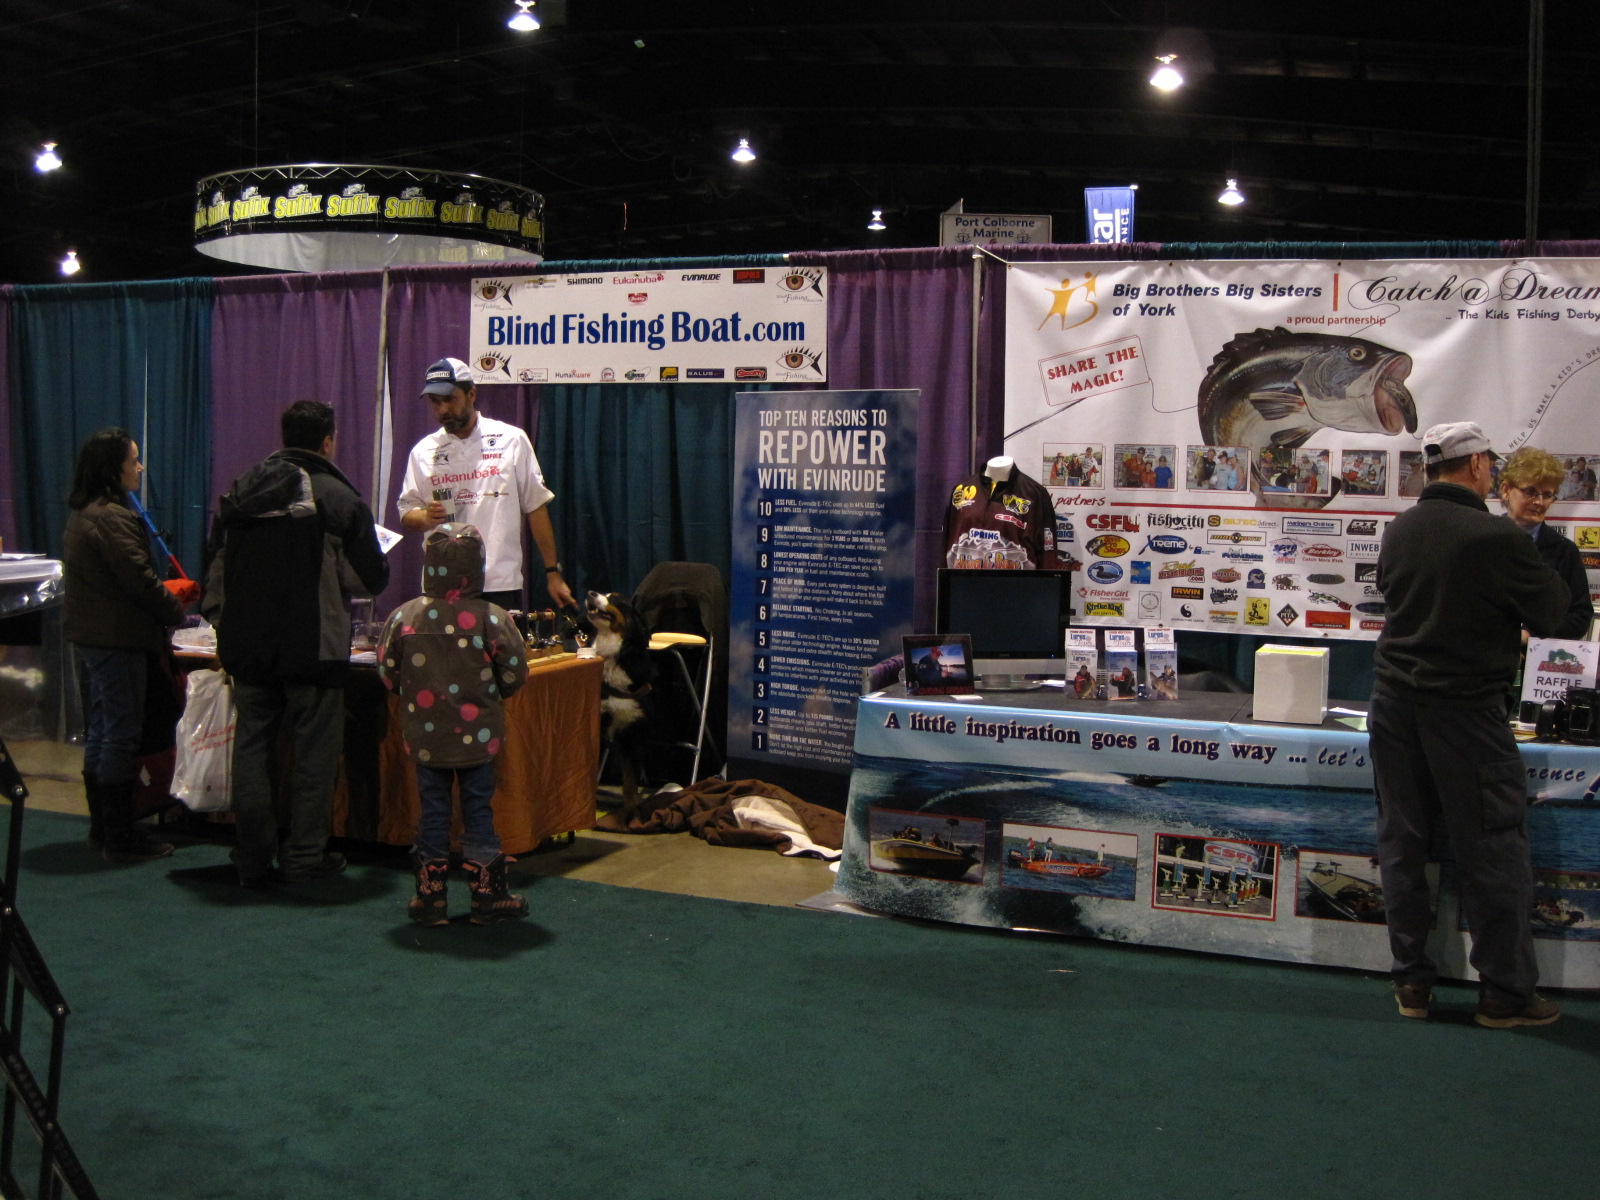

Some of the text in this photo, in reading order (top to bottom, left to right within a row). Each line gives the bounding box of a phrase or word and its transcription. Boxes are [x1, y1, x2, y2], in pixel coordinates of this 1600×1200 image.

[233, 196, 271, 221] Sufix
[274, 193, 323, 219] Sufix
[327, 193, 380, 217] Sufix
[385, 197, 436, 218] Sufix
[440, 202, 484, 223] Sufix
[956, 217, 1035, 228] Port Colborne
[973, 228, 1014, 238] Marine
[567, 277, 603, 286] SHIMANO
[613, 275, 657, 285] Eukanuba
[682, 274, 721, 282] EVINRUDE
[1113, 284, 1322, 299] Big Brothers Big Sisters
[1113, 303, 1177, 317] of York
[1458, 309, 1479, 320] The
[1485, 309, 1510, 320] Kids
[1517, 309, 1560, 321] Fishing
[1566, 308, 1600, 322] Derby
[1286, 315, 1387, 326] a proud partnership
[488, 311, 805, 351] Blind Fishing Boat.com
[1047, 347, 1139, 380] SHARE THE
[1070, 370, 1125, 394] MAGIC!
[1508, 431, 1526, 449] HELP
[1528, 418, 1537, 429] US
[1536, 393, 1551, 415] MAKE
[1557, 358, 1582, 380] KID'S
[759, 410, 887, 427] TOP TEN REASONS TO
[758, 430, 887, 465] REPOWER
[430, 469, 490, 487] Eukanuba
[758, 468, 886, 492] WITH EVINRUDE
[1056, 494, 1106, 509] partners
[760, 502, 771, 516] 10
[762, 528, 768, 542] 9
[970, 531, 999, 540] SPRING
[1307, 548, 1339, 557] Berkley
[1350, 543, 1379, 552] INWEB
[761, 554, 767, 568] 8
[761, 580, 766, 594] 7
[760, 606, 766, 620] 6
[759, 632, 765, 646] 5
[758, 658, 764, 671] 4
[1536, 676, 1582, 688] RAFFLE
[758, 683, 764, 697] 3
[757, 709, 764, 723] 2
[757, 735, 761, 748] 1
[884, 711, 901, 729] A
[909, 712, 957, 734] little
[965, 716, 1082, 744] inspiration
[1090, 732, 1138, 750] goes
[1147, 736, 1160, 752] a
[1170, 734, 1220, 760] long
[1230, 742, 1278, 765] way
[1316, 748, 1366, 767] let's
